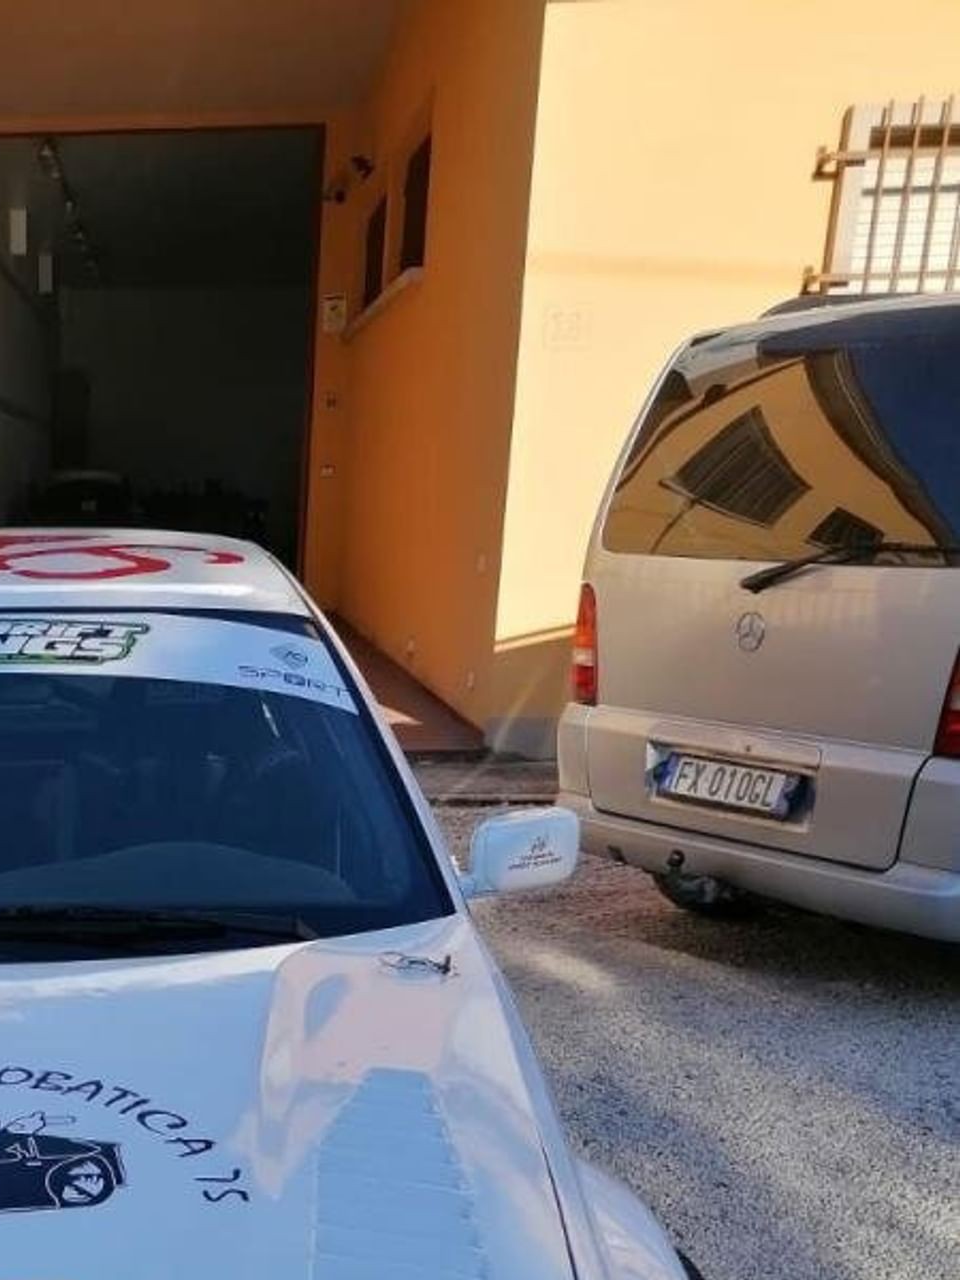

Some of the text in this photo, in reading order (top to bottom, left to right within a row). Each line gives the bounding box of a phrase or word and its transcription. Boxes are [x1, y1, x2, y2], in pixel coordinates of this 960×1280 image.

[237, 665, 352, 697] SPORT
[674, 760, 706, 794] FX
[194, 1168, 250, 1202] 75
